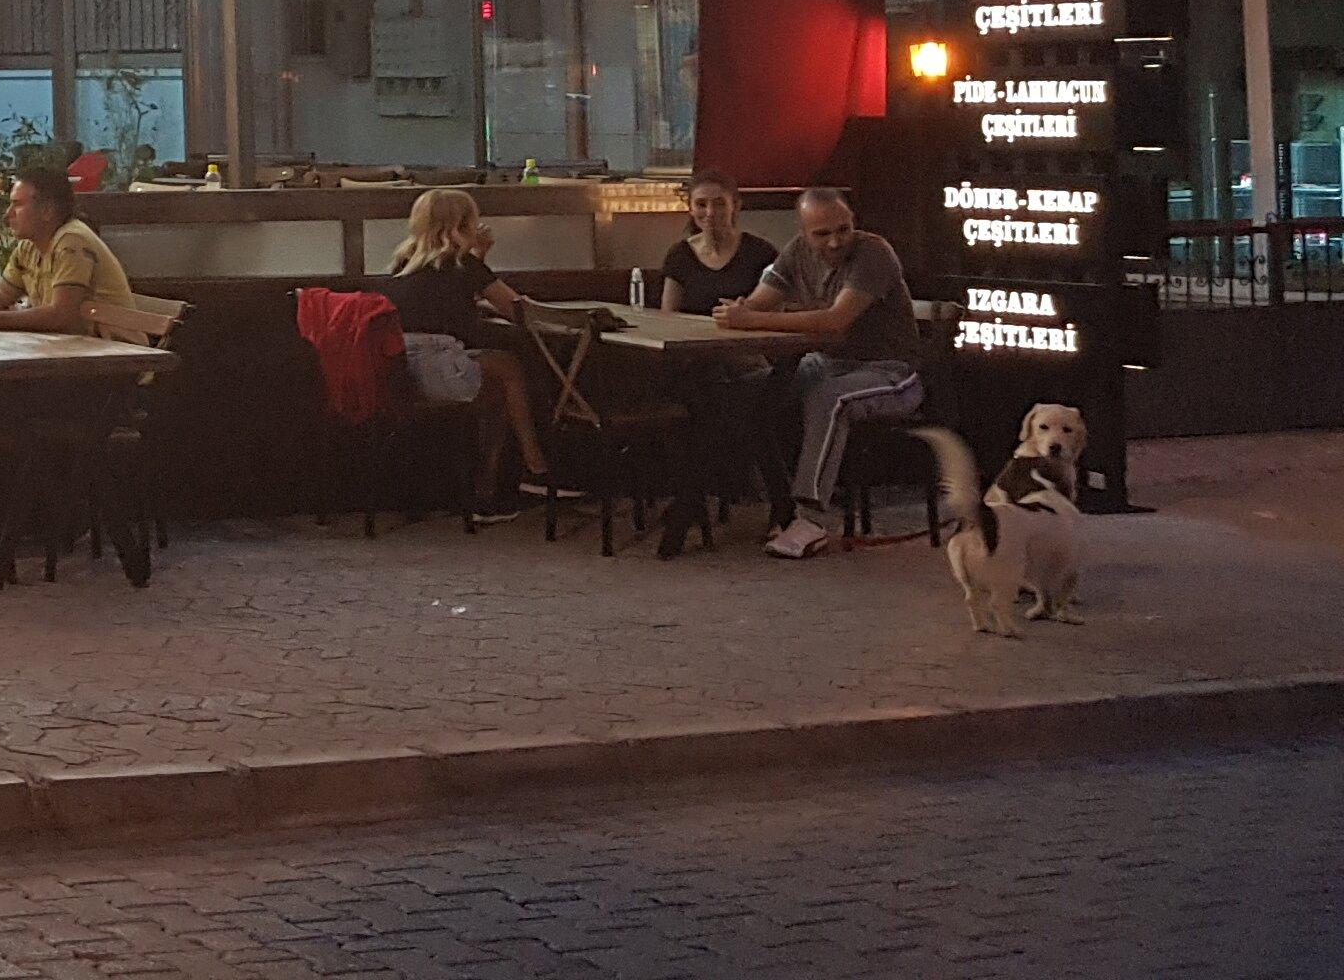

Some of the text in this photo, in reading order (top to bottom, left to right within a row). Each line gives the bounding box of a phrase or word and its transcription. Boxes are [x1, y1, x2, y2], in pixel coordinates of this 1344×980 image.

[981, 108, 1078, 143] ÇEŞİTLERİ
[963, 214, 1081, 248] ÇEŞİTLERİ
[966, 288, 1057, 317] IZGARA
